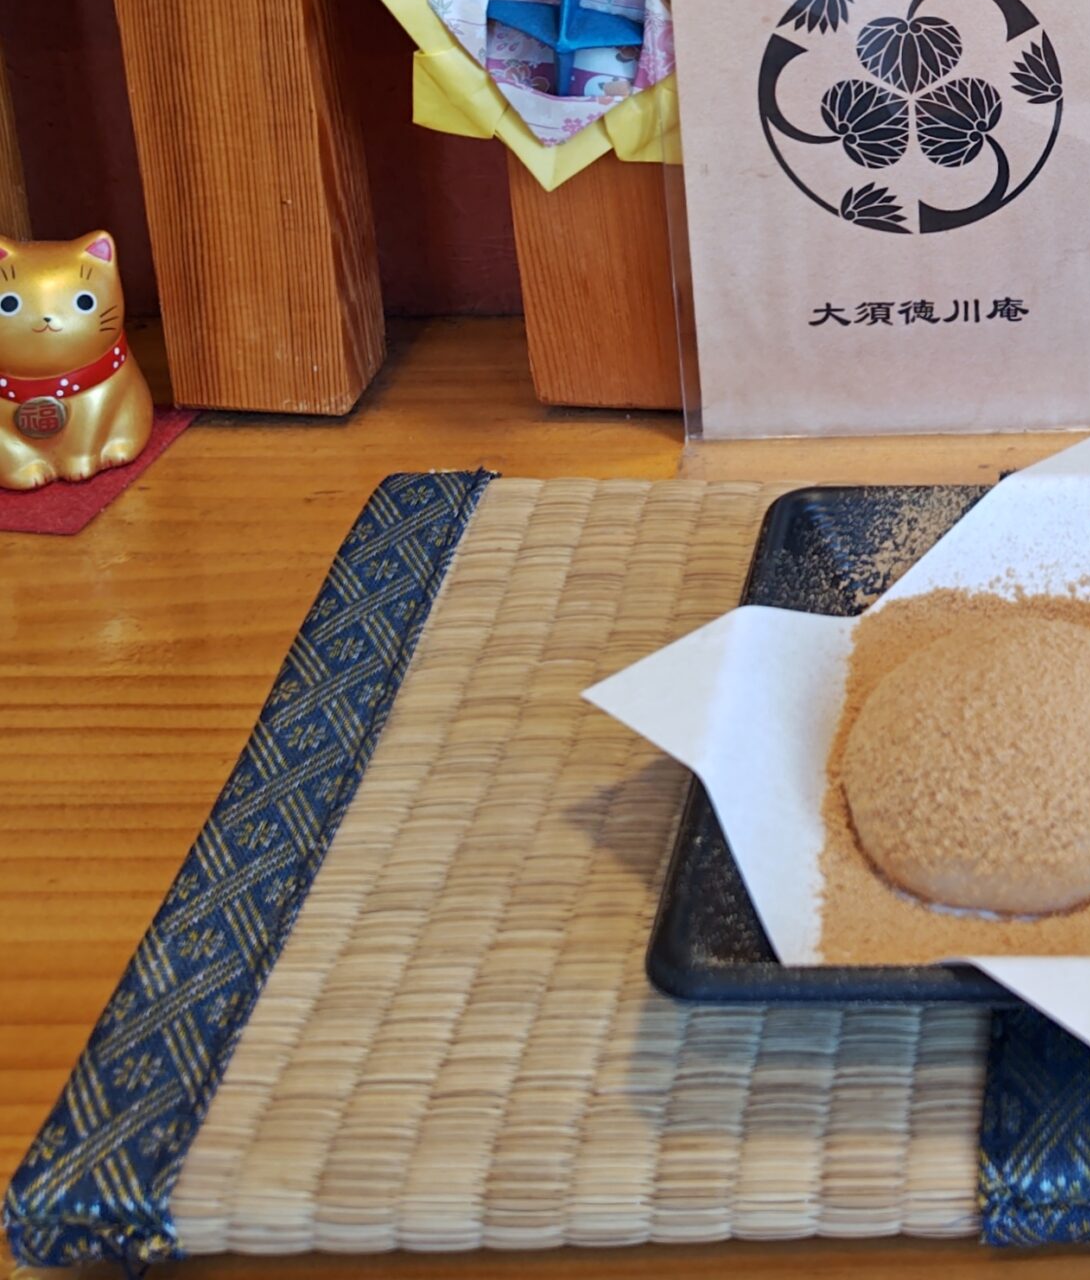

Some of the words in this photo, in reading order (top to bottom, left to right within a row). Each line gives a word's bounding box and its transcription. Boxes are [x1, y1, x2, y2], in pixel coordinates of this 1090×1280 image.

[808, 296, 1030, 326] 大須徳川庵
